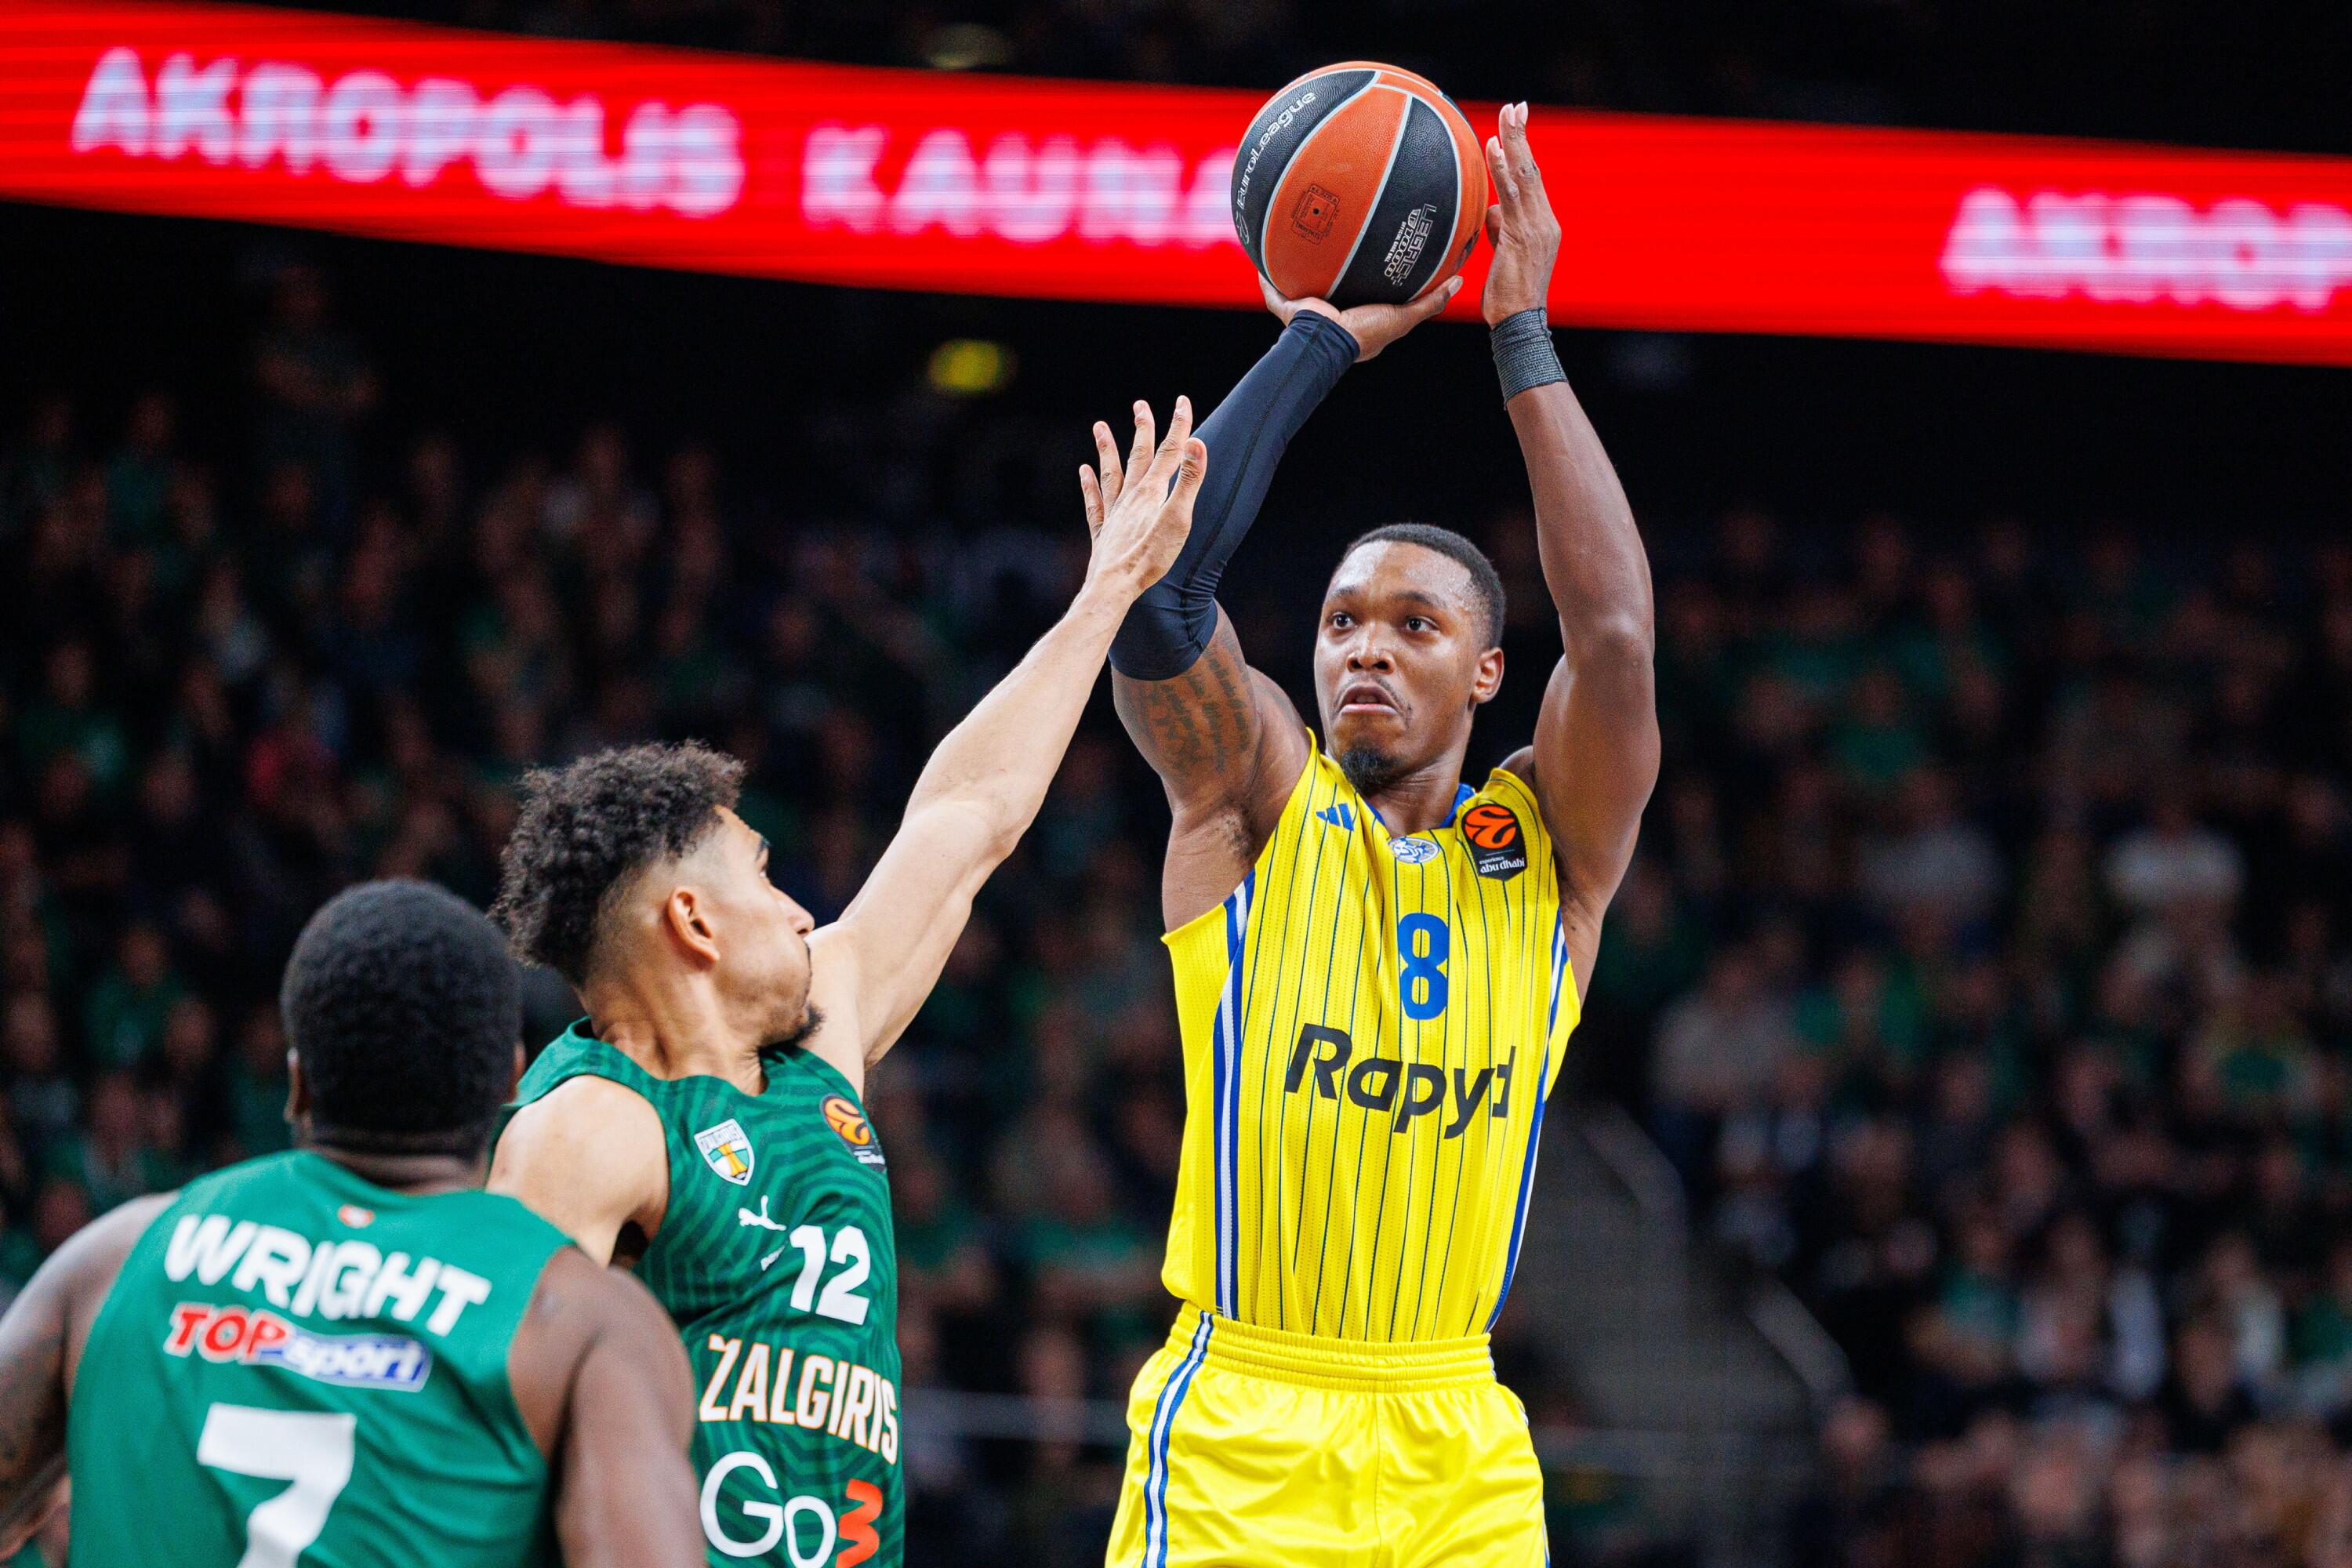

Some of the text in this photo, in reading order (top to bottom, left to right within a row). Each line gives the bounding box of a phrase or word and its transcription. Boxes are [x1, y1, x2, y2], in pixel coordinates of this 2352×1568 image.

[72, 47, 745, 218] AKROPOLIS
[1236, 92, 1316, 210] EuroLeague
[1479, 857, 1525, 873] abu dhabi
[1398, 913, 1449, 1020] 8
[164, 1214, 492, 1336] WRIGHT
[789, 1225, 870, 1326] 12
[197, 1403, 357, 1568] 7
